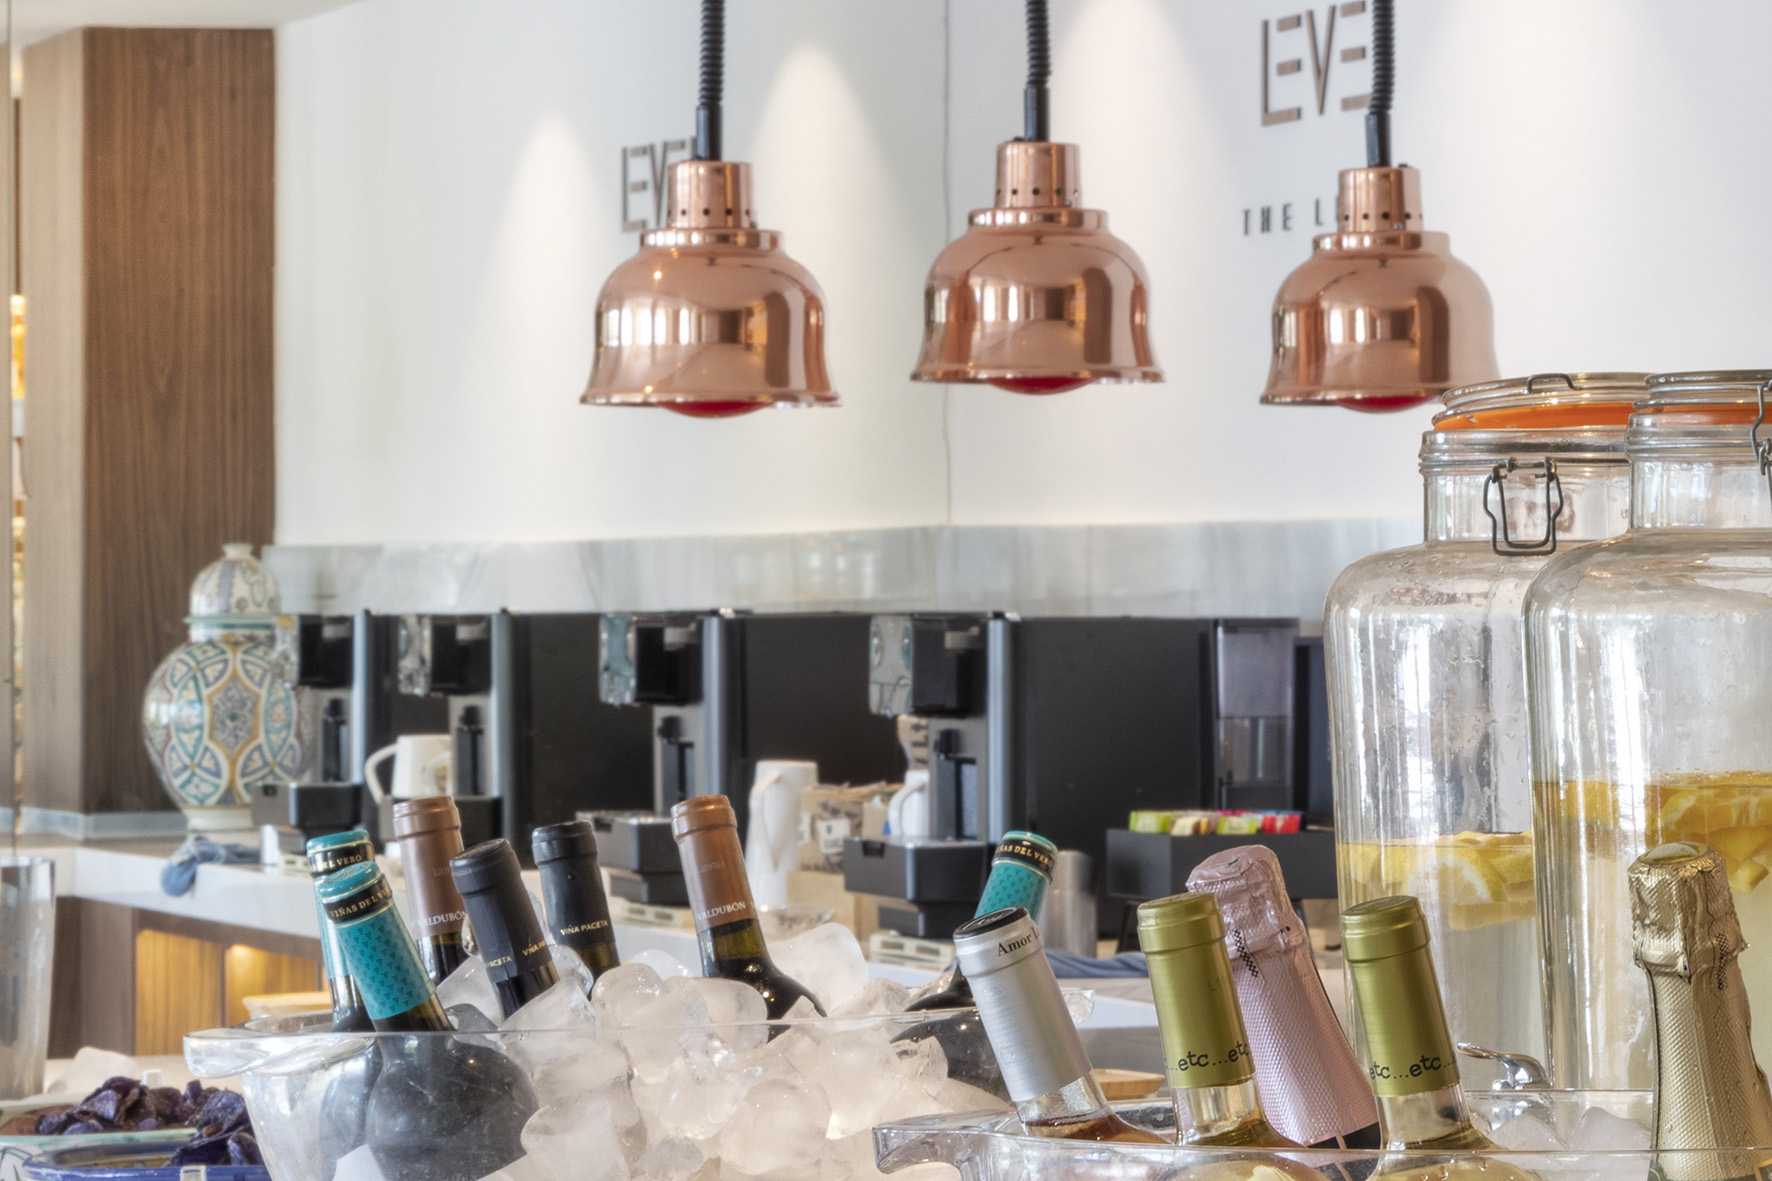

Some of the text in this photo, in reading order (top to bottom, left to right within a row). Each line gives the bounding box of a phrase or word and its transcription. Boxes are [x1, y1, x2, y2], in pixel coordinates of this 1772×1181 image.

[1242, 203, 1293, 236] THE
[1014, 845, 1033, 857] DEL
[329, 904, 358, 918] VIÑAS
[358, 896, 378, 909] DEL
[560, 919, 610, 937] VIÑA PACETA
[997, 934, 1031, 956] Amor
